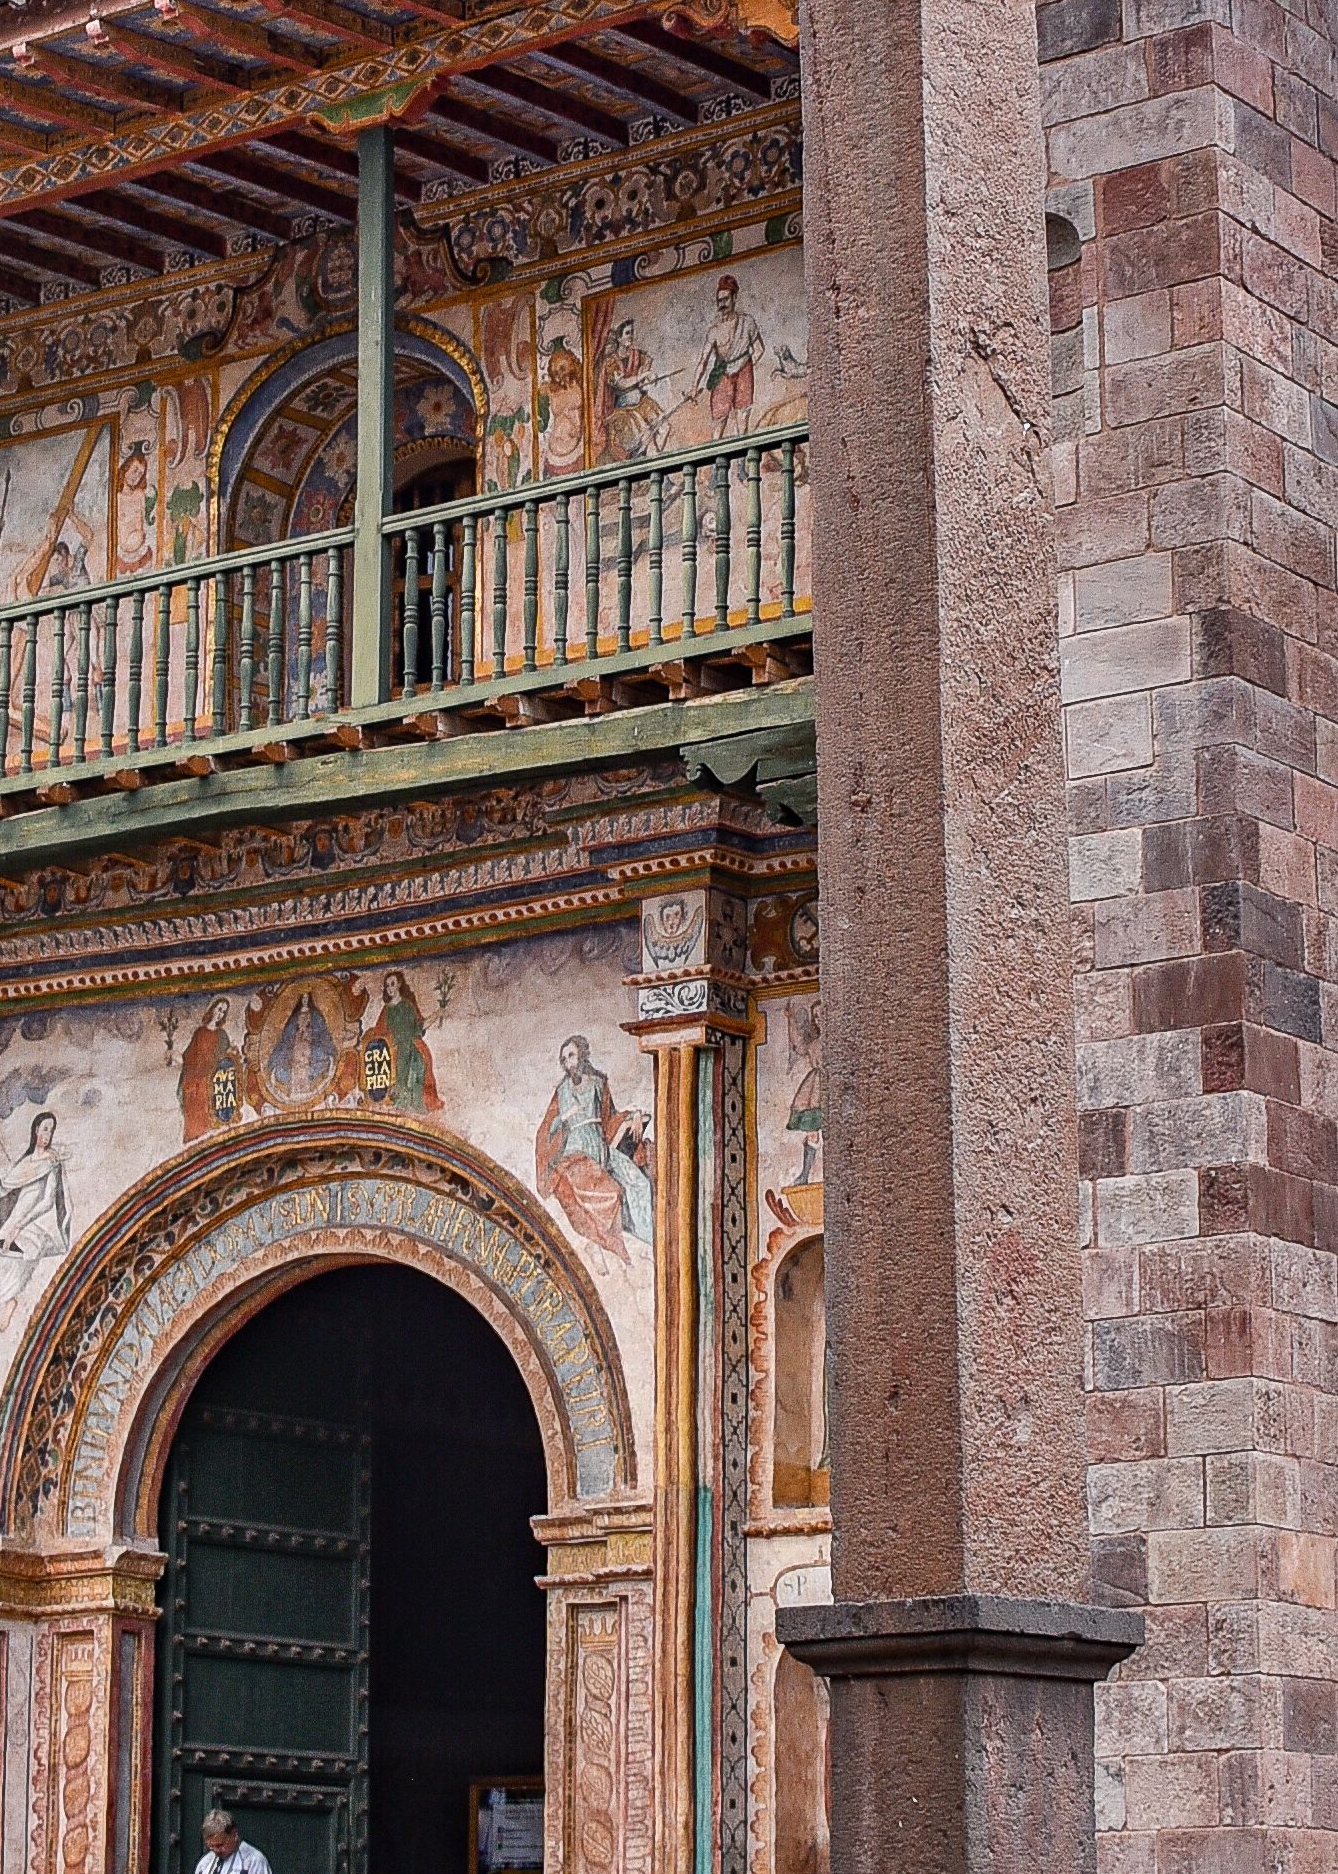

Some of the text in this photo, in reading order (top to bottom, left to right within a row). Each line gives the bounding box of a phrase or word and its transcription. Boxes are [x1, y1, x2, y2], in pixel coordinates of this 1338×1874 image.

[212, 1067, 235, 1083] AVE
[214, 1081, 234, 1095] MA
[215, 1092, 237, 1110] RIA
